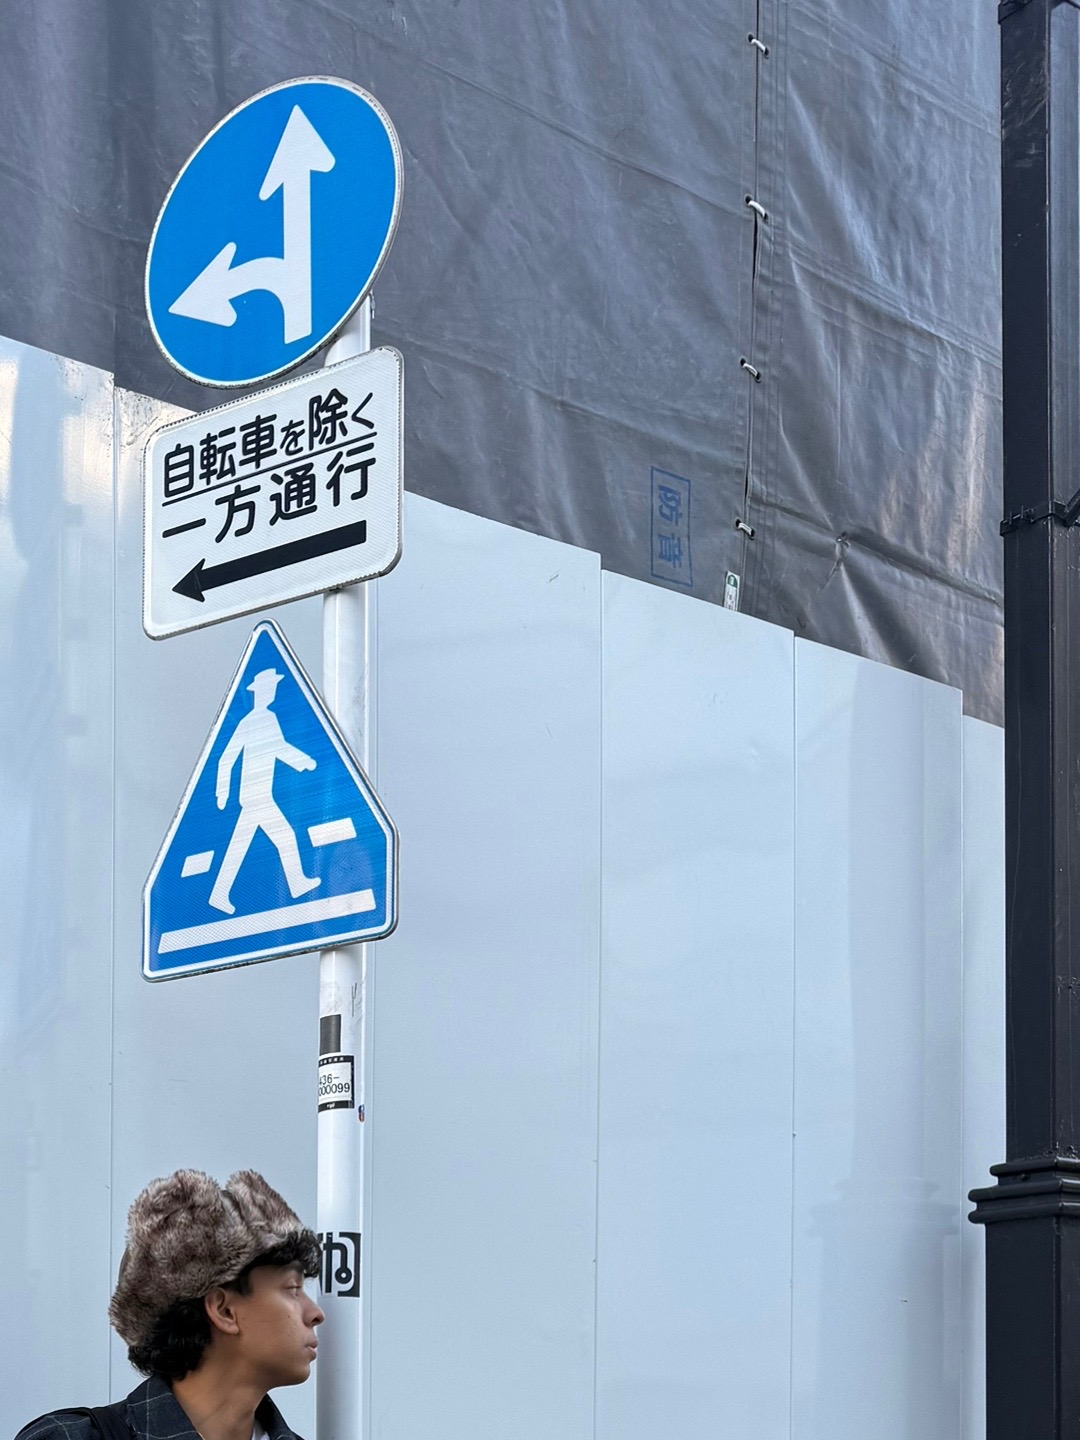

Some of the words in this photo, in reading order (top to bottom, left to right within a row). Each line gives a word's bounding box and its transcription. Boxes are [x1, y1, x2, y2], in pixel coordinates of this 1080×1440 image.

[162, 442, 377, 544] 一方通行
[164, 388, 376, 498] 自転車を除く
[658, 485, 683, 568] 防音
